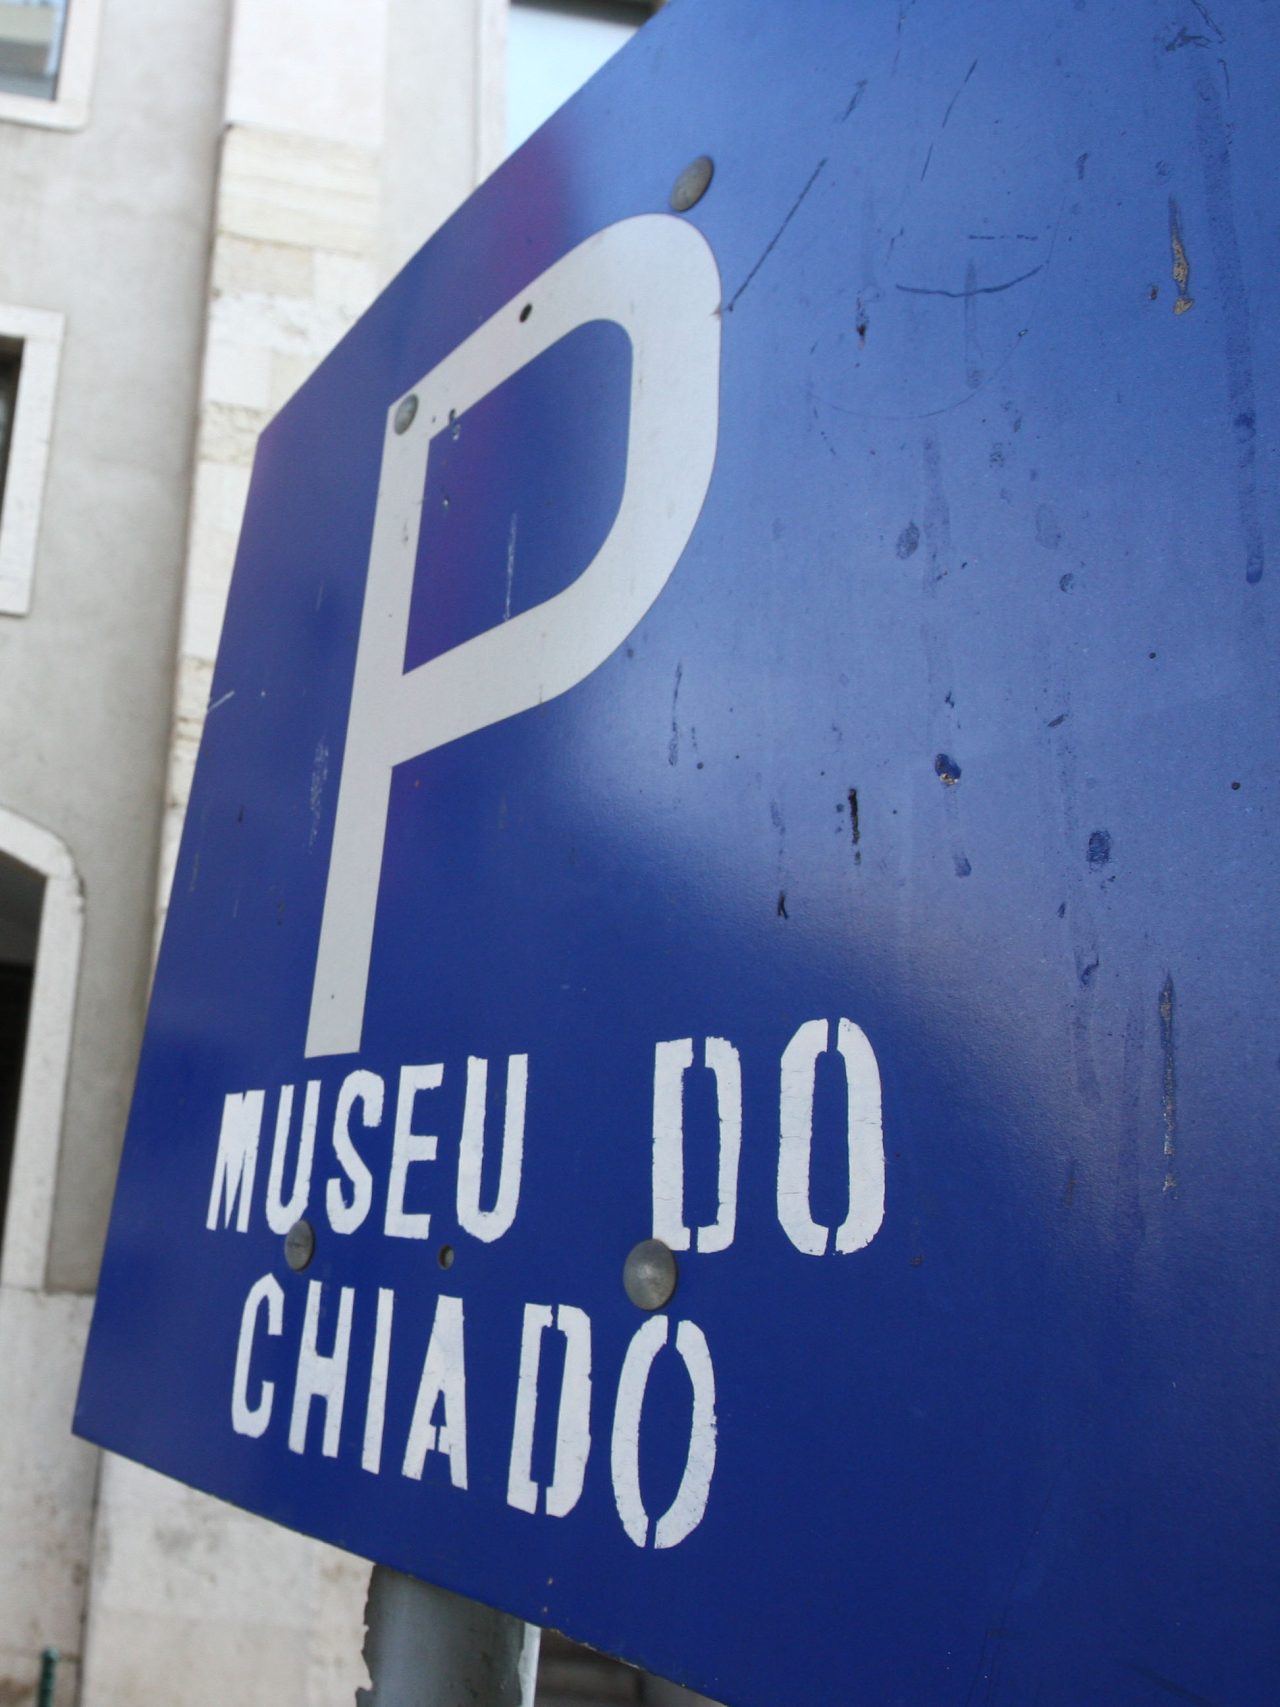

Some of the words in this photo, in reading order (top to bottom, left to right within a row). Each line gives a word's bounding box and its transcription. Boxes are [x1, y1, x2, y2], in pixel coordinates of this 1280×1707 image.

[304, 212, 721, 1058] P
[206, 1053, 529, 1244] MUSEU
[651, 1016, 887, 1257] DO
[230, 1272, 718, 1550] CHIADO
